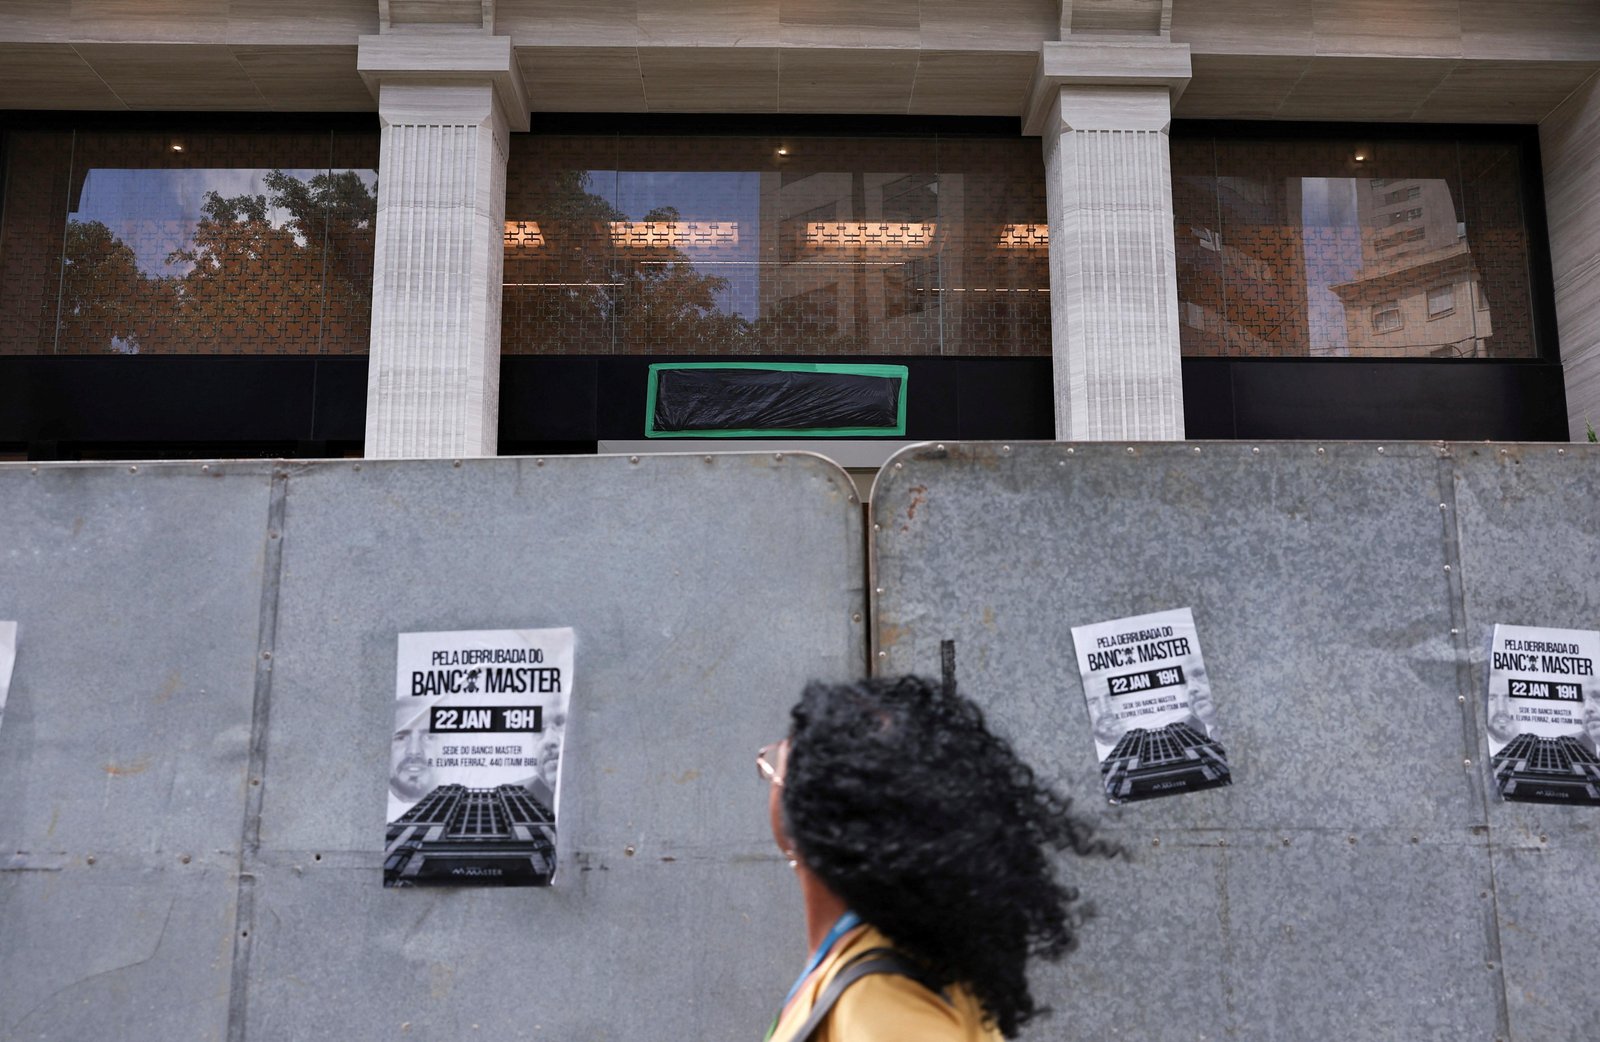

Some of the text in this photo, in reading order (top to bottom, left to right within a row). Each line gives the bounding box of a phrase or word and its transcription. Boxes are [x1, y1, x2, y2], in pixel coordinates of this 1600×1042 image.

[1097, 626, 1173, 648] PELA DERRUBADA DO
[1505, 639, 1579, 654] PELA DERRUBADA DO
[432, 648, 543, 666] PELA DERRUBADA DO
[1137, 637, 1191, 662] MASTER
[1542, 655, 1593, 676] MASTER
[486, 668, 561, 693] MASTER
[1112, 669, 1179, 693] 22 JAN 19H
[1512, 682, 1577, 698] 22 JAN 19H
[435, 710, 534, 729] 22 JAN 19H
[442, 746, 522, 755] SEDE DO BANCO MASTER
[436, 758, 458, 767] ELVIRA
[490, 758, 501, 766] 440
